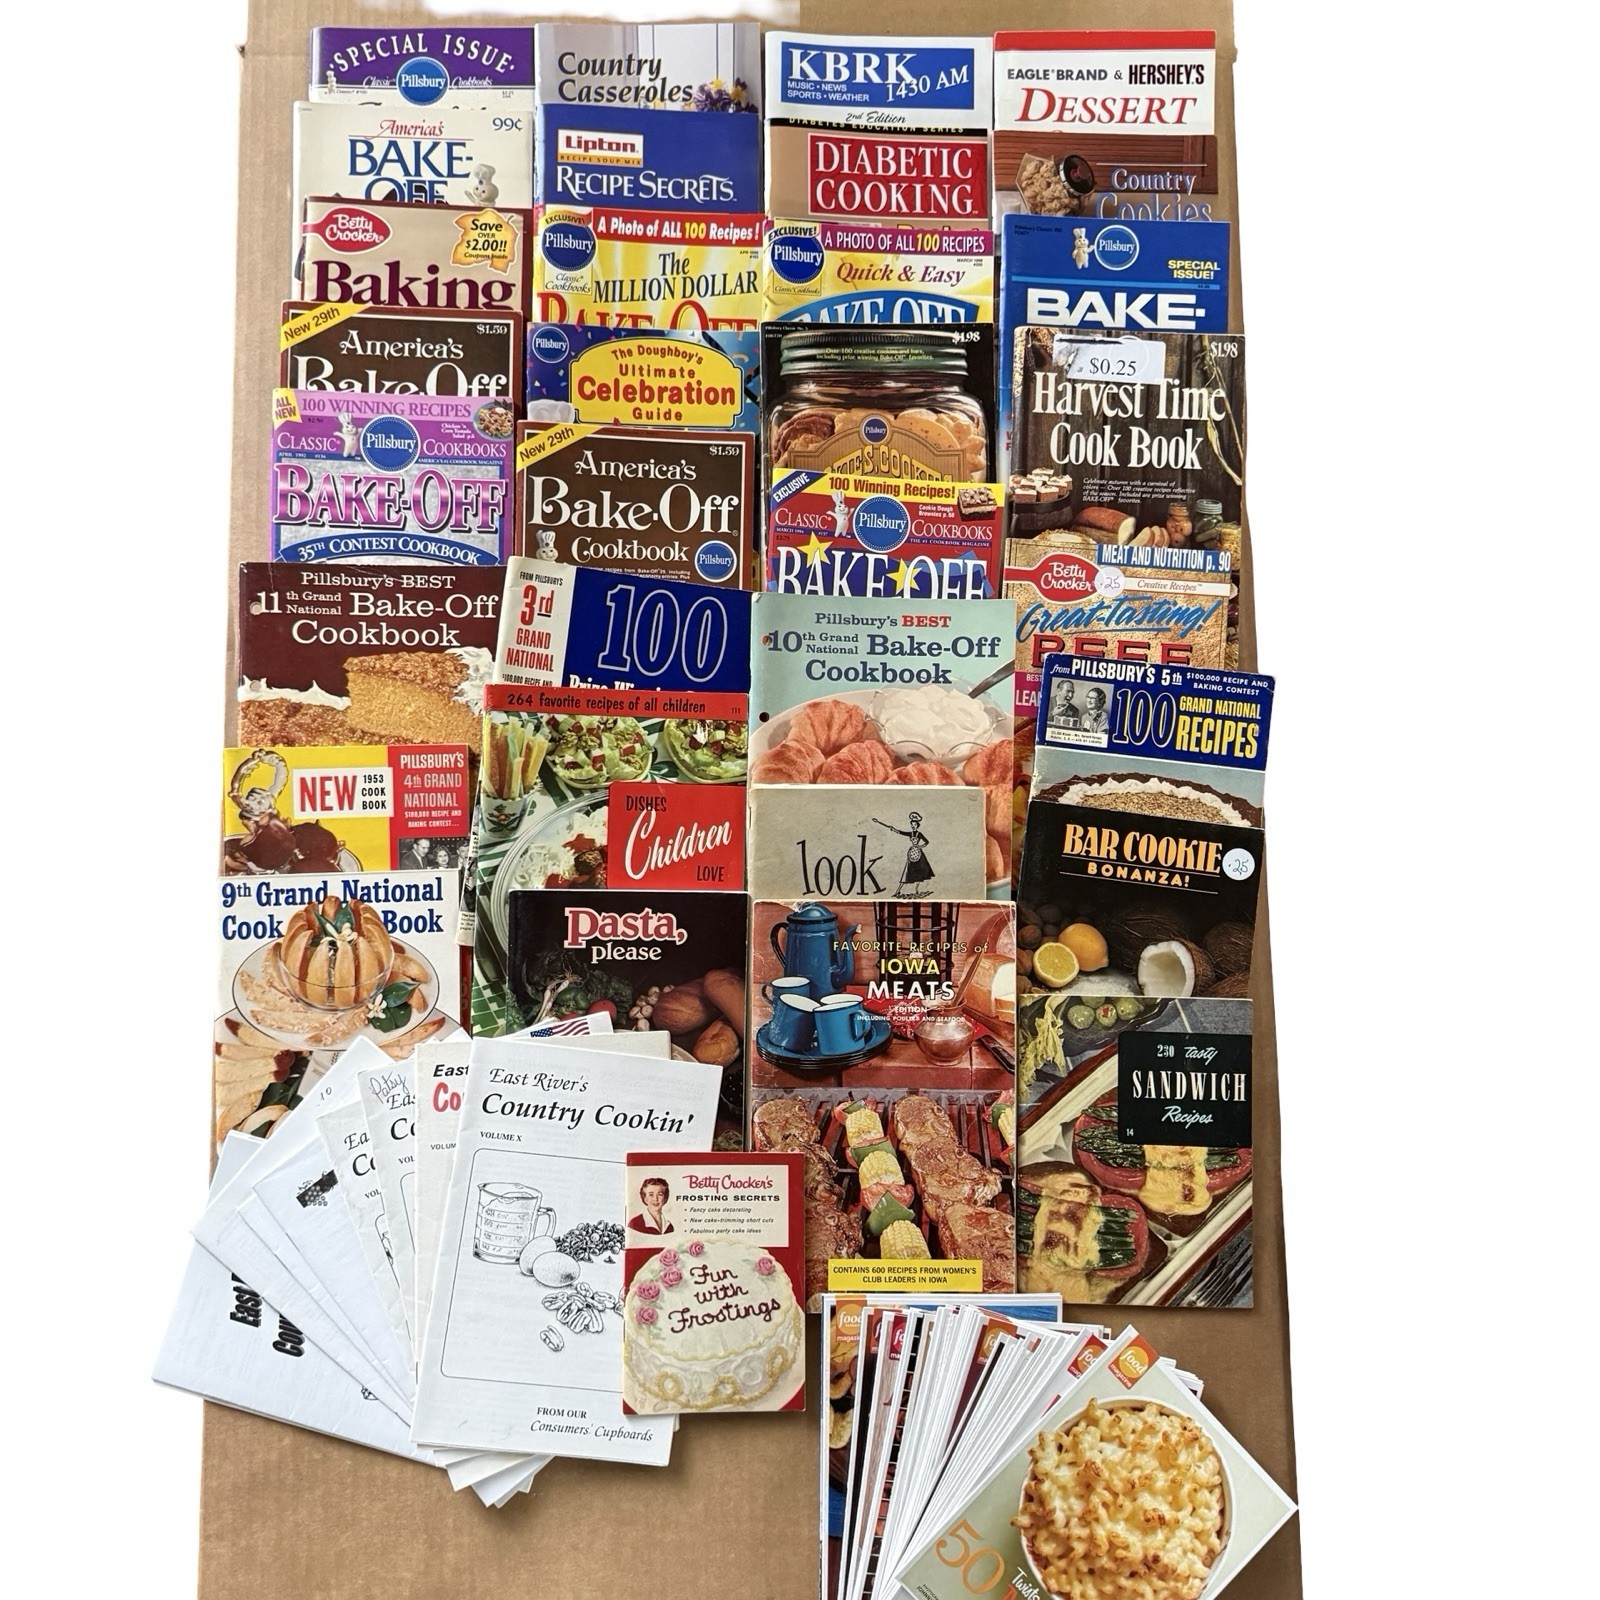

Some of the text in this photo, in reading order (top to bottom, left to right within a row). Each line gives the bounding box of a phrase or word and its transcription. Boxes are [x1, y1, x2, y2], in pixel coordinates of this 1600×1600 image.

[333, 33, 512, 74] SPECIAL ISSUE
[558, 52, 662, 81] Country
[789, 48, 917, 84] KBRK
[1007, 64, 1205, 85] EAGLE BRAND & HERSHEY'S
[558, 77, 693, 103] Casseroles
[787, 81, 847, 91] MUSIC NEWS
[787, 90, 869, 102] SPORTS WEATHER
[1014, 87, 1198, 125] DESSERT
[846, 111, 906, 124] 2nd Edition
[380, 119, 444, 137] America's
[565, 135, 636, 153] Lipton
[348, 138, 473, 178] BAKE-
[560, 155, 593, 163] RECIPE
[597, 157, 621, 165] SOUP
[815, 141, 973, 179] DIABETIC
[1111, 167, 1197, 196] Country
[816, 178, 973, 215] COOKING
[332, 214, 373, 230] Betty
[471, 219, 503, 233] Save
[326, 224, 380, 243] Crocker
[545, 232, 593, 253] Pillsbury
[466, 240, 507, 252] $2.00!!
[773, 245, 823, 266] Pillsbury
[1099, 240, 1135, 254] Pillsbury
[658, 252, 690, 276] The
[1168, 260, 1221, 271] SPECIAL
[1173, 270, 1214, 280] ISSUE!
[593, 271, 758, 303] MILLION DOLLAR
[1027, 288, 1205, 330] BAKE-
[477, 324, 507, 334] $1.59
[952, 331, 980, 344] $1.98
[340, 330, 464, 361] America's
[619, 363, 696, 379] Ultimate
[1089, 358, 1137, 377] $0.25
[276, 396, 292, 408] ALL
[302, 398, 471, 417] 100 WINNING RECIPES
[275, 406, 296, 420] NEW
[865, 427, 886, 435] Pillsbury
[277, 432, 506, 457] CLASSIC Pillsbury COOKBOOKS
[709, 446, 739, 456] $1.59
[1050, 422, 1122, 466] Cook
[1128, 425, 1204, 470] Book
[575, 450, 697, 481] America's
[773, 472, 810, 502] EXCLUSIVE
[829, 477, 956, 499] 100 Winning Recipes!
[273, 463, 506, 532] BAKE-OFF
[527, 475, 739, 533] Bake-Off
[699, 554, 733, 566] Pillsbury
[520, 571, 563, 586] FROM PILLSBURY'S
[1049, 562, 1087, 579] Betty
[301, 572, 456, 590] Pillsbury's BEST
[1040, 573, 1092, 592] Crocker
[1138, 580, 1197, 591] Creative Recipes
[286, 605, 342, 615] National
[815, 612, 951, 629] Pillsbury's BEST
[292, 619, 460, 646] Cookbook
[516, 628, 551, 649] GRAND
[598, 584, 728, 683] 100
[806, 644, 858, 655] National
[506, 648, 554, 672] NATIONAL
[805, 659, 952, 684] Cookbook
[1186, 672, 1220, 682] $100,000
[1223, 677, 1249, 686] RECIPE
[1193, 683, 1260, 695] BAKING CONTEST
[508, 693, 705, 713] 264 favorite recipes of all children
[1176, 715, 1259, 759] RECIPES
[299, 774, 384, 812] NEW 1953
[362, 788, 386, 797] COOK
[404, 793, 458, 808] NATIONAL
[362, 801, 387, 810] BOOK
[624, 807, 732, 880] Children
[1062, 823, 1223, 874] BAR COOKIE
[697, 866, 725, 882] LOVE
[796, 835, 886, 897] look
[222, 908, 443, 941] Cook Book
[564, 907, 688, 949] Pasta,
[591, 942, 662, 964] please
[833, 941, 988, 953] FAVORITE RECIPES of
[880, 959, 940, 975] IOWA
[867, 980, 956, 1001] MEATS
[489, 1068, 589, 1092] East River's
[1132, 1070, 1247, 1102] SANDWICH
[482, 1093, 694, 1134] Country Cookin'
[1161, 1106, 1214, 1129] Recipes
[480, 1132, 515, 1142] VOLUME
[682, 1174, 773, 1194] Betty Crocker's
[690, 1264, 738, 1285] Fun
[694, 1283, 749, 1304] with
[668, 1298, 781, 1333] Frostings
[537, 1407, 587, 1419] FROM OUR
[530, 1421, 653, 1441] Consumers' Cupboards
